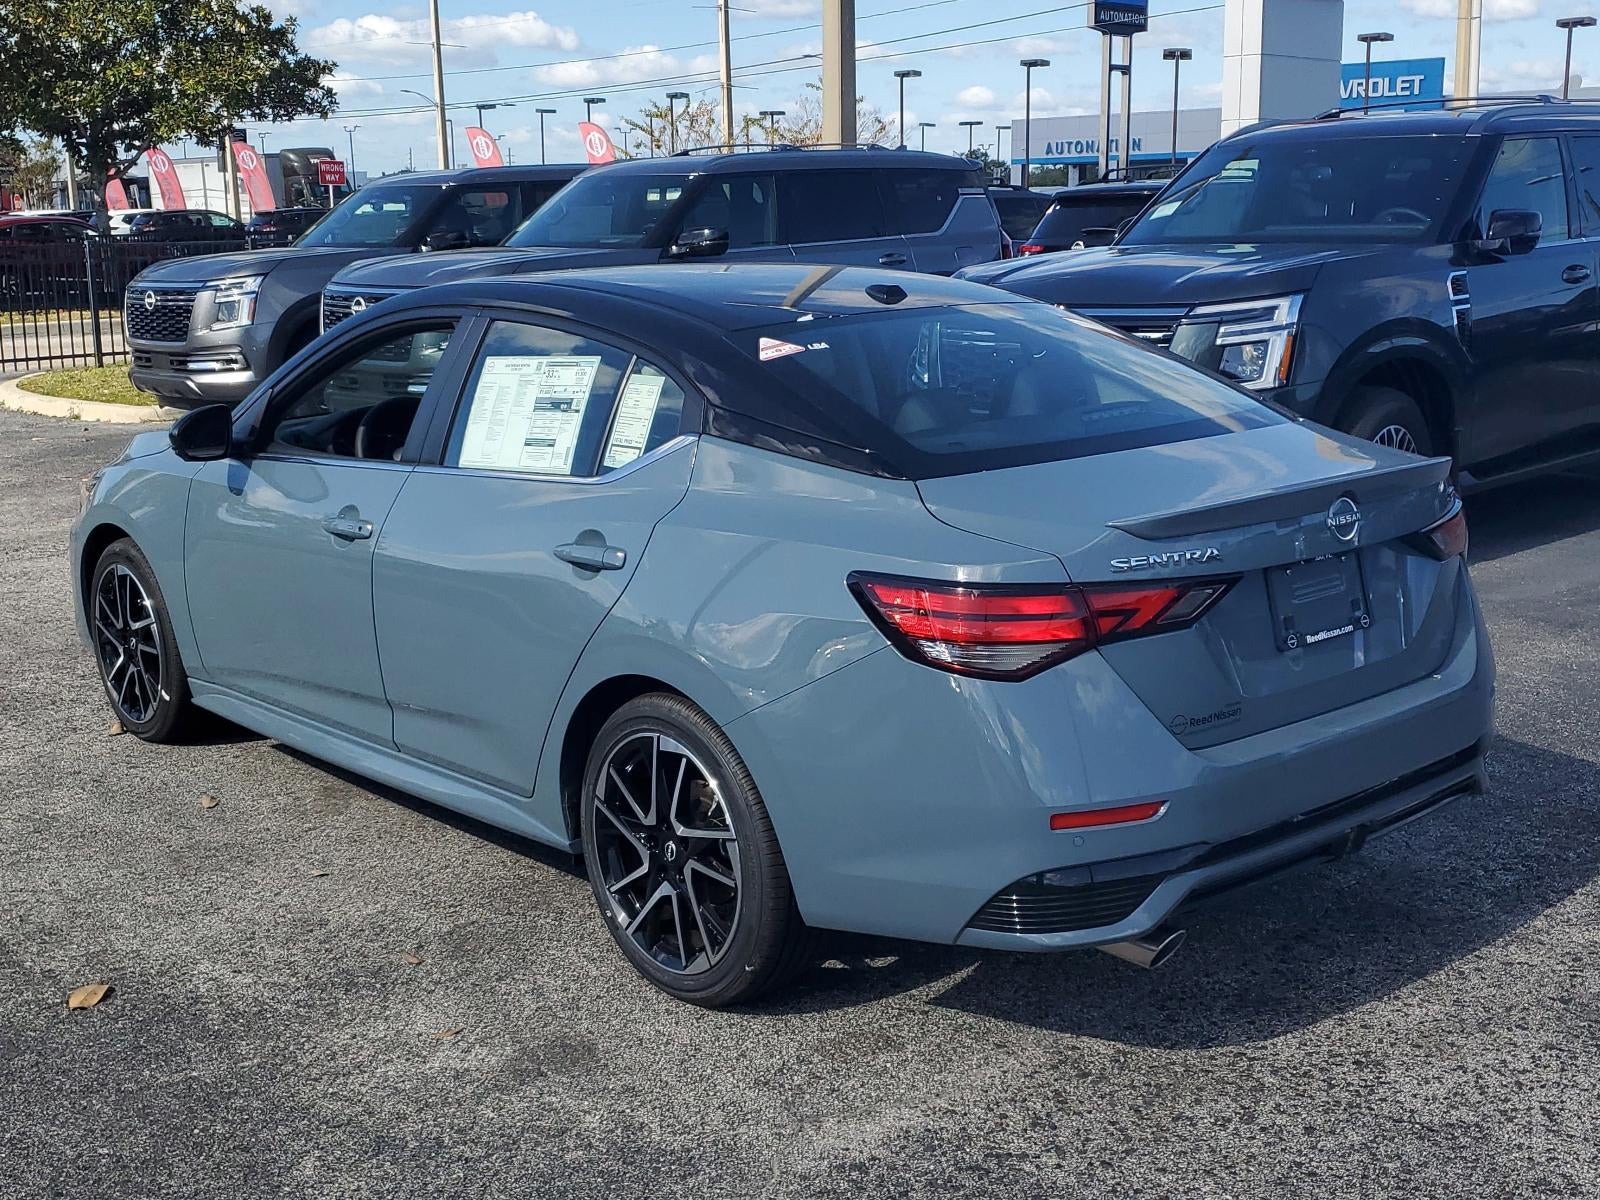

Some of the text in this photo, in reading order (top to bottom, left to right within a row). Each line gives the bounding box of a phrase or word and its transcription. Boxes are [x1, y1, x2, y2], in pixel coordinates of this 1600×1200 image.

[1100, 10, 1145, 24] AUTONATION
[1045, 137, 1142, 156] AUTONTIN
[320, 163, 344, 172] WRONG
[325, 174, 340, 182] WAY
[1328, 512, 1361, 527] NISSAN
[1110, 547, 1221, 573] SENTRA
[1306, 625, 1354, 644] ReedNissan.com
